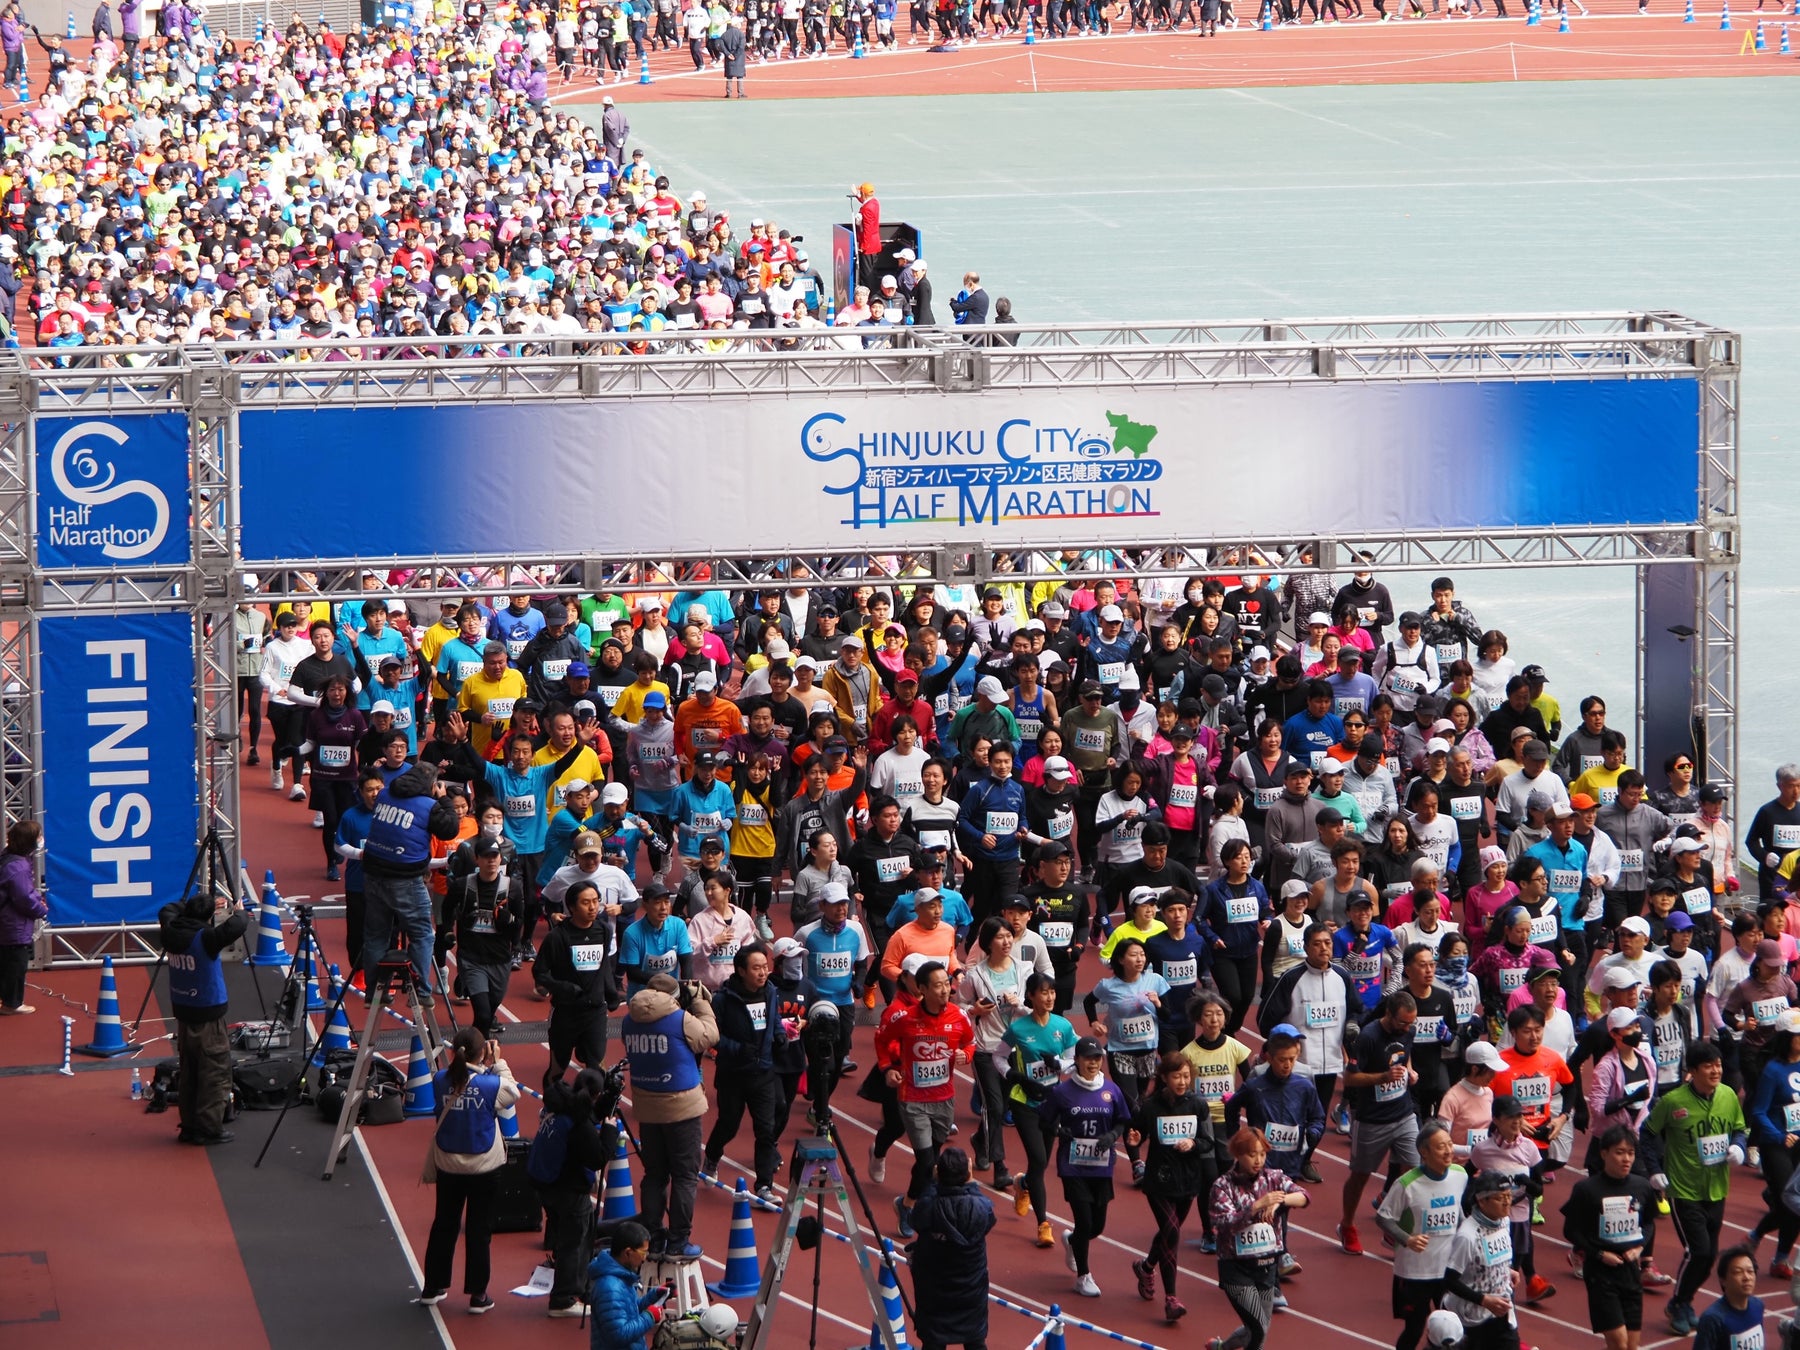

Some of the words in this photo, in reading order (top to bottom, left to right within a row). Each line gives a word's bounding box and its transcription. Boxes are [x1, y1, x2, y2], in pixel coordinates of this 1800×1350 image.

[801, 412, 985, 494] SHINJUKU
[997, 419, 1082, 464] CITY
[865, 463, 1158, 487] 新宿シティハーフマラソン・区民健康マラソン
[853, 487, 945, 529] HALF
[959, 483, 1151, 527] MARATHON
[50, 504, 93, 525] Half
[50, 524, 151, 546] Marathon
[1159, 591, 1179, 601] 57263
[1240, 601, 1246, 613] I
[1237, 613, 1261, 625] NY
[1397, 678, 1415, 691] 5239
[492, 703, 514, 713] 53560
[1338, 701, 1362, 711] 54309
[1079, 733, 1103, 745] 54295
[324, 751, 347, 760] 57269
[642, 747, 666, 757] 56194
[85, 639, 152, 897] FINISH
[898, 781, 922, 792] 57257
[1171, 788, 1195, 800] 56205
[507, 800, 532, 810] 53564
[1455, 802, 1479, 813] 54284
[373, 803, 414, 830] PHOTO
[741, 807, 764, 818] 57307
[695, 817, 719, 827] 57312
[990, 816, 1015, 827] 52400
[1053, 818, 1073, 832] 58089
[1117, 828, 1140, 839] 58071
[1777, 830, 1800, 841] 54237
[1622, 854, 1641, 865] 2365
[882, 861, 907, 873] 52401
[1554, 874, 1579, 886] 52389
[1231, 903, 1256, 915] 56154
[1044, 927, 1070, 938] 52470
[1530, 920, 1554, 934] 52403
[576, 950, 600, 961] 52460
[712, 945, 738, 956] 55135
[648, 956, 674, 968] 54321
[821, 957, 848, 969] 54366
[1167, 964, 1194, 977] 51339
[1504, 974, 1526, 986] 5515
[1310, 1006, 1336, 1019] 53425
[1758, 1002, 1786, 1017] 57188
[1123, 1020, 1152, 1034] 56138
[626, 1034, 668, 1054] PHOTO
[918, 1064, 947, 1079] 53433
[1199, 1063, 1229, 1073] TEEDA
[448, 1086, 480, 1095] PSS
[1200, 1080, 1229, 1093] 57336
[1517, 1083, 1547, 1097] 51282
[1082, 1120, 1097, 1136] 15
[1162, 1122, 1193, 1135] 56157
[1269, 1129, 1297, 1142] 53444
[1427, 1211, 1456, 1226] 53436
[1604, 1218, 1635, 1234] 51022
[1240, 1228, 1272, 1243] 56141
